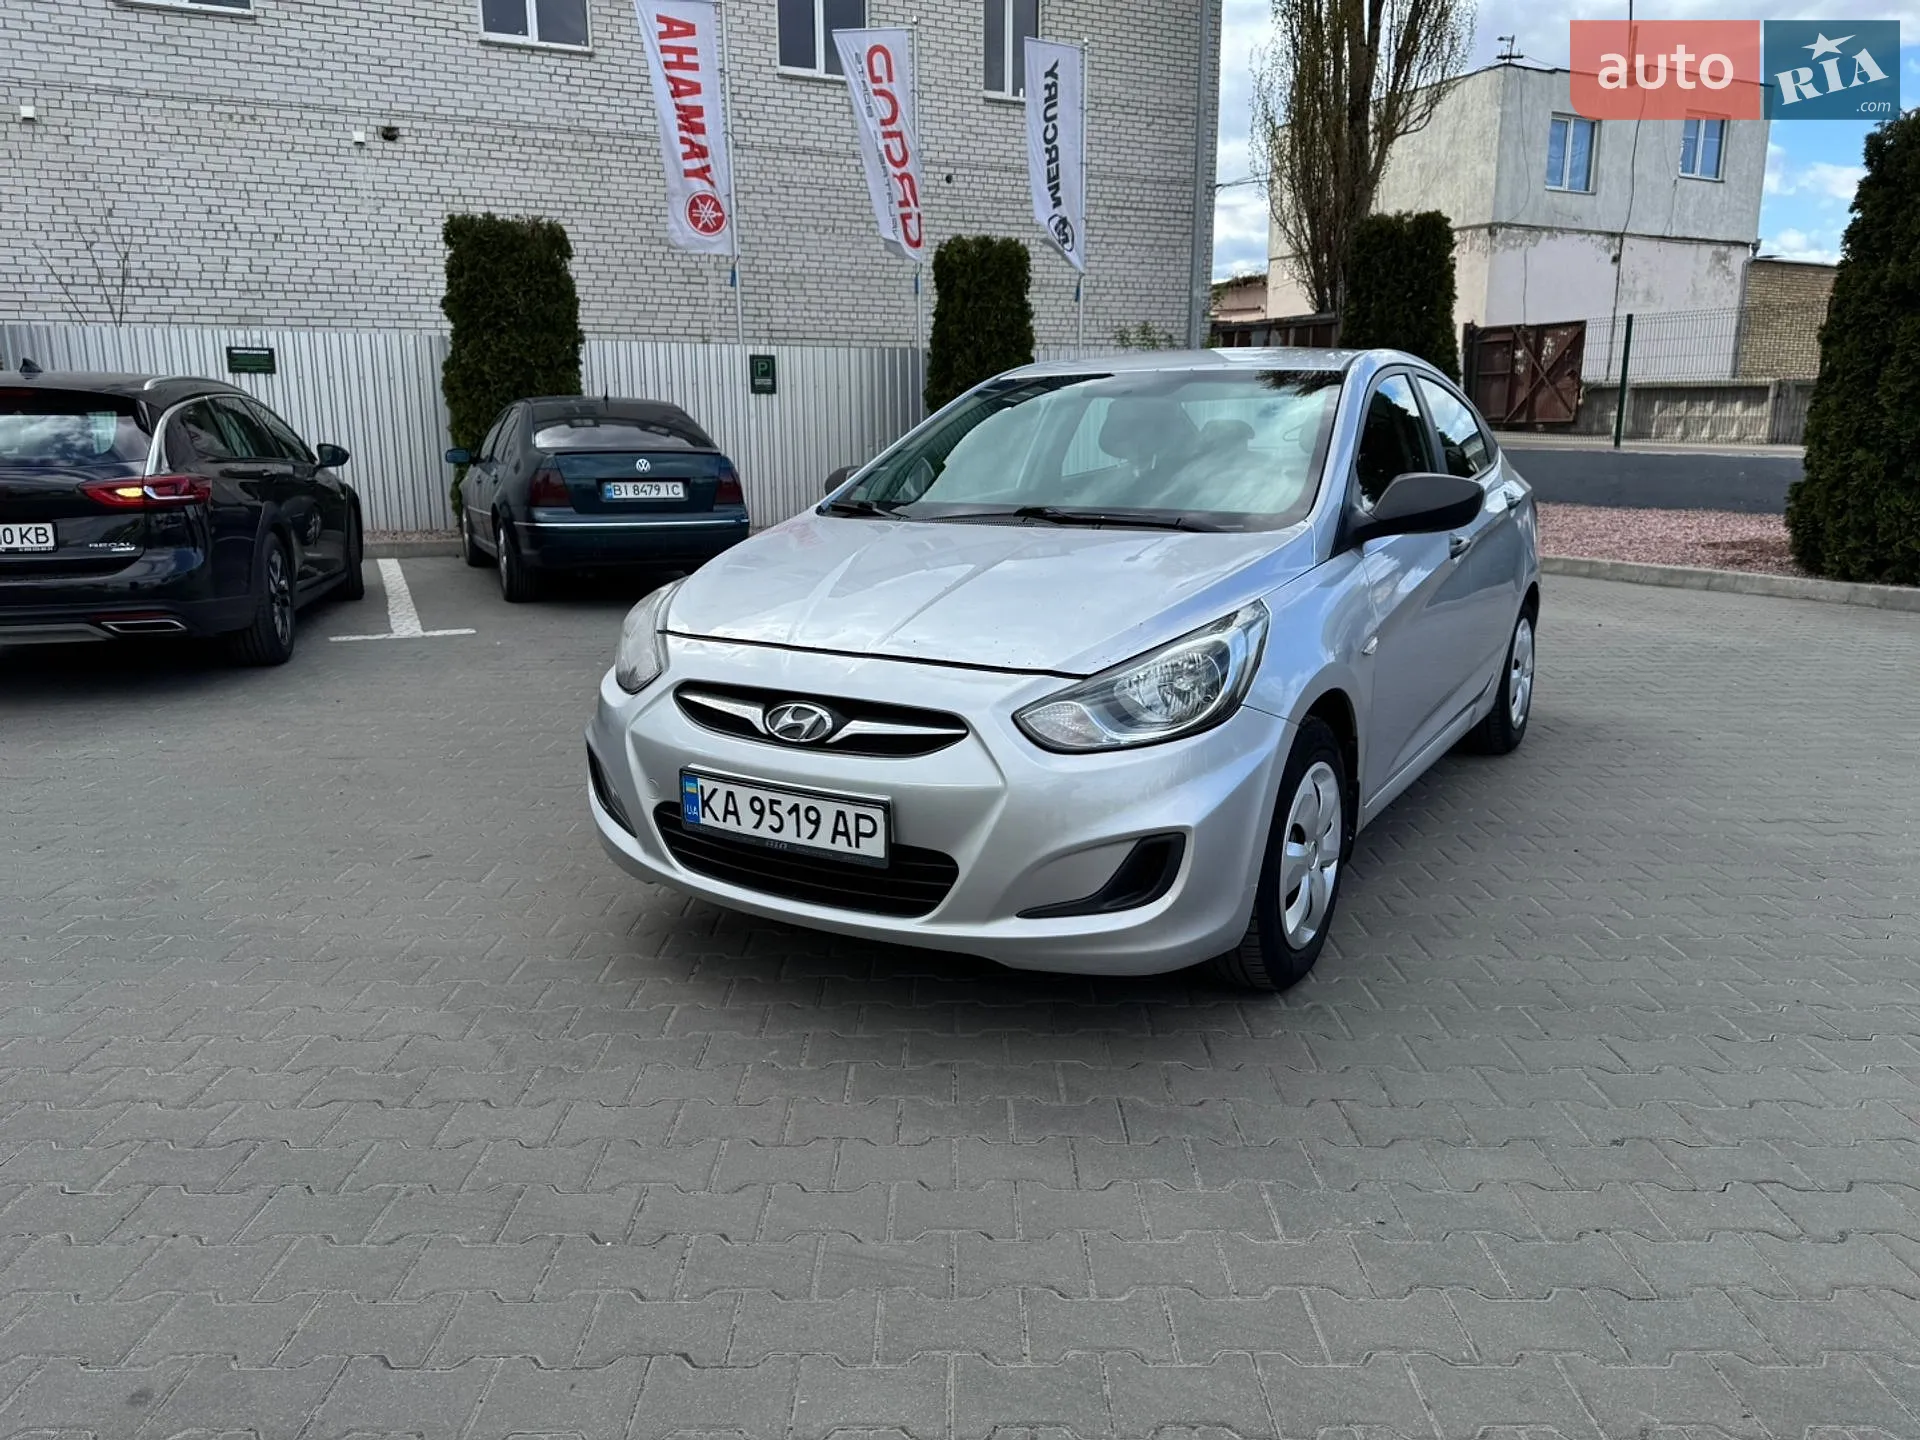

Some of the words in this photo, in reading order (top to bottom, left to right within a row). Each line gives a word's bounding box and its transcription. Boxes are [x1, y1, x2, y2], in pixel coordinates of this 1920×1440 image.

[757, 362, 768, 376] P
[613, 484, 628, 495] BI
[633, 484, 660, 495] 8479
[665, 484, 680, 495] IC
[0, 527, 14, 544] 0
[19, 527, 49, 544] KB
[686, 804, 699, 816] UA
[700, 785, 741, 826] KA
[749, 796, 821, 840] 9519
[831, 810, 877, 849] AP
